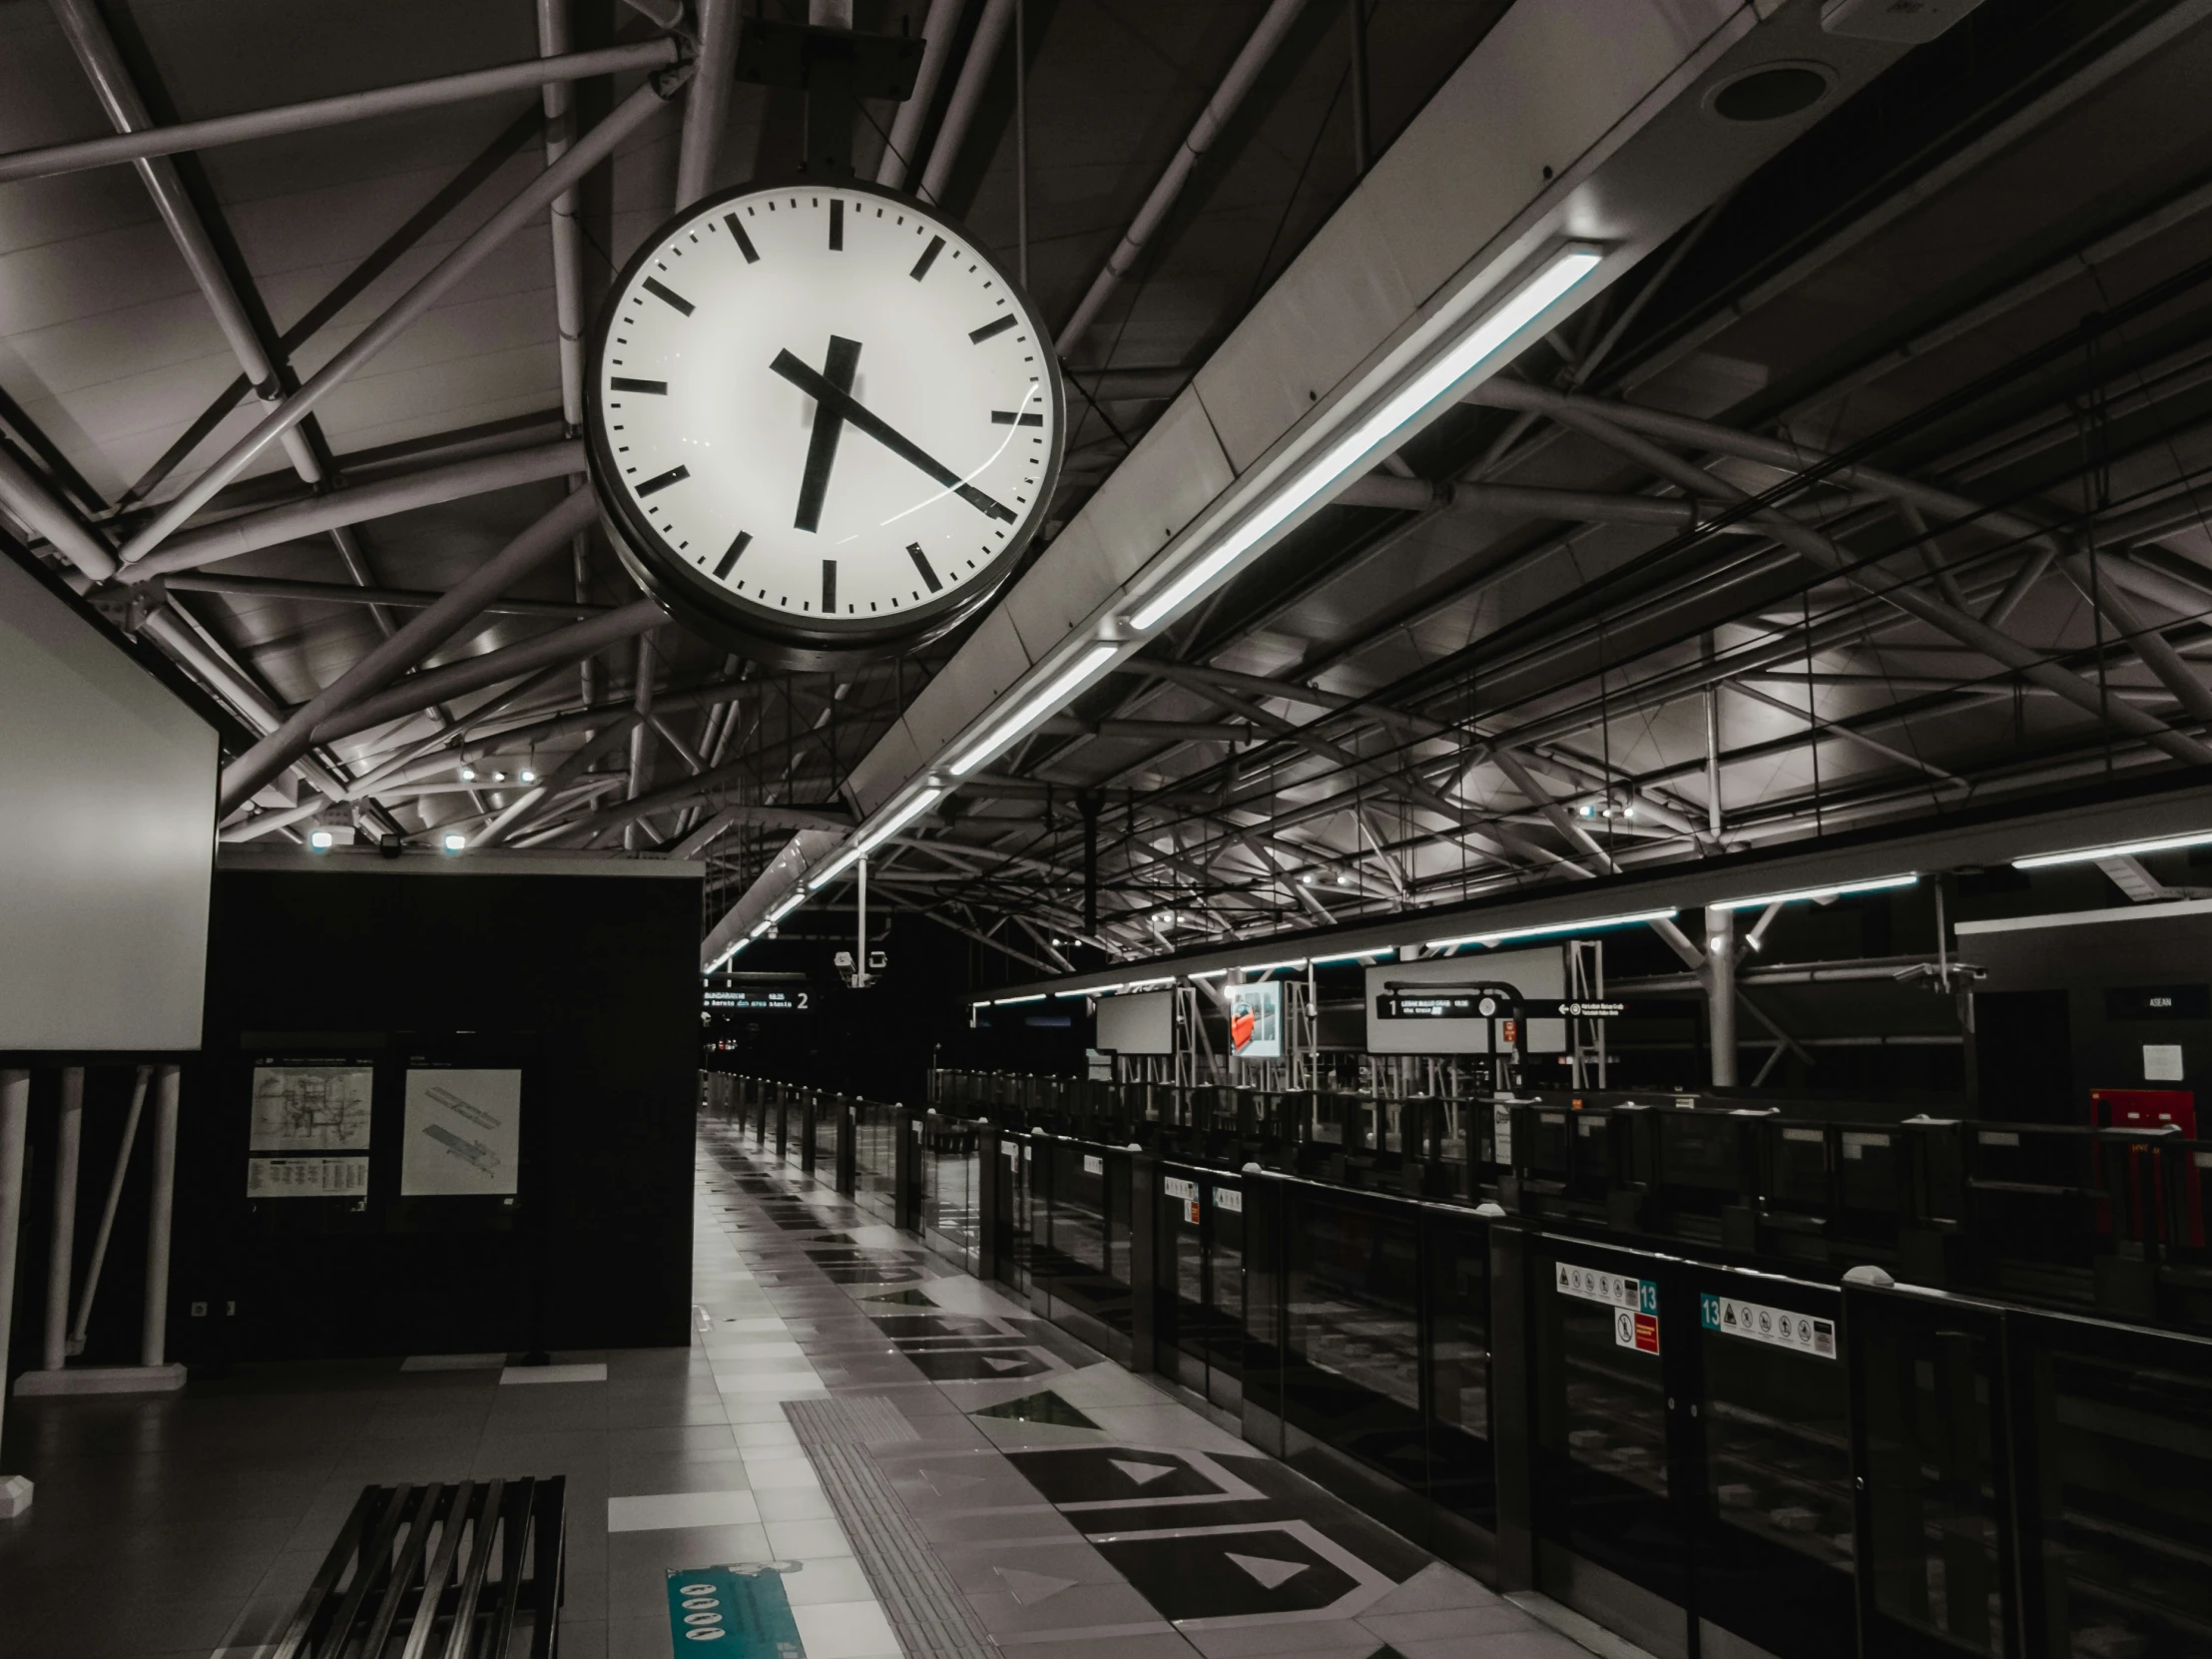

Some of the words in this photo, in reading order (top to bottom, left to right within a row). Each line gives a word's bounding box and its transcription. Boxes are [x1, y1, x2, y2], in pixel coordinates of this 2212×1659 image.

[797, 992, 809, 1009] 2
[1388, 999, 1396, 1016] 1
[2149, 997, 2172, 1007] ASEAN
[1641, 1285, 1657, 1311] 13
[1702, 1299, 1720, 1326] 13
